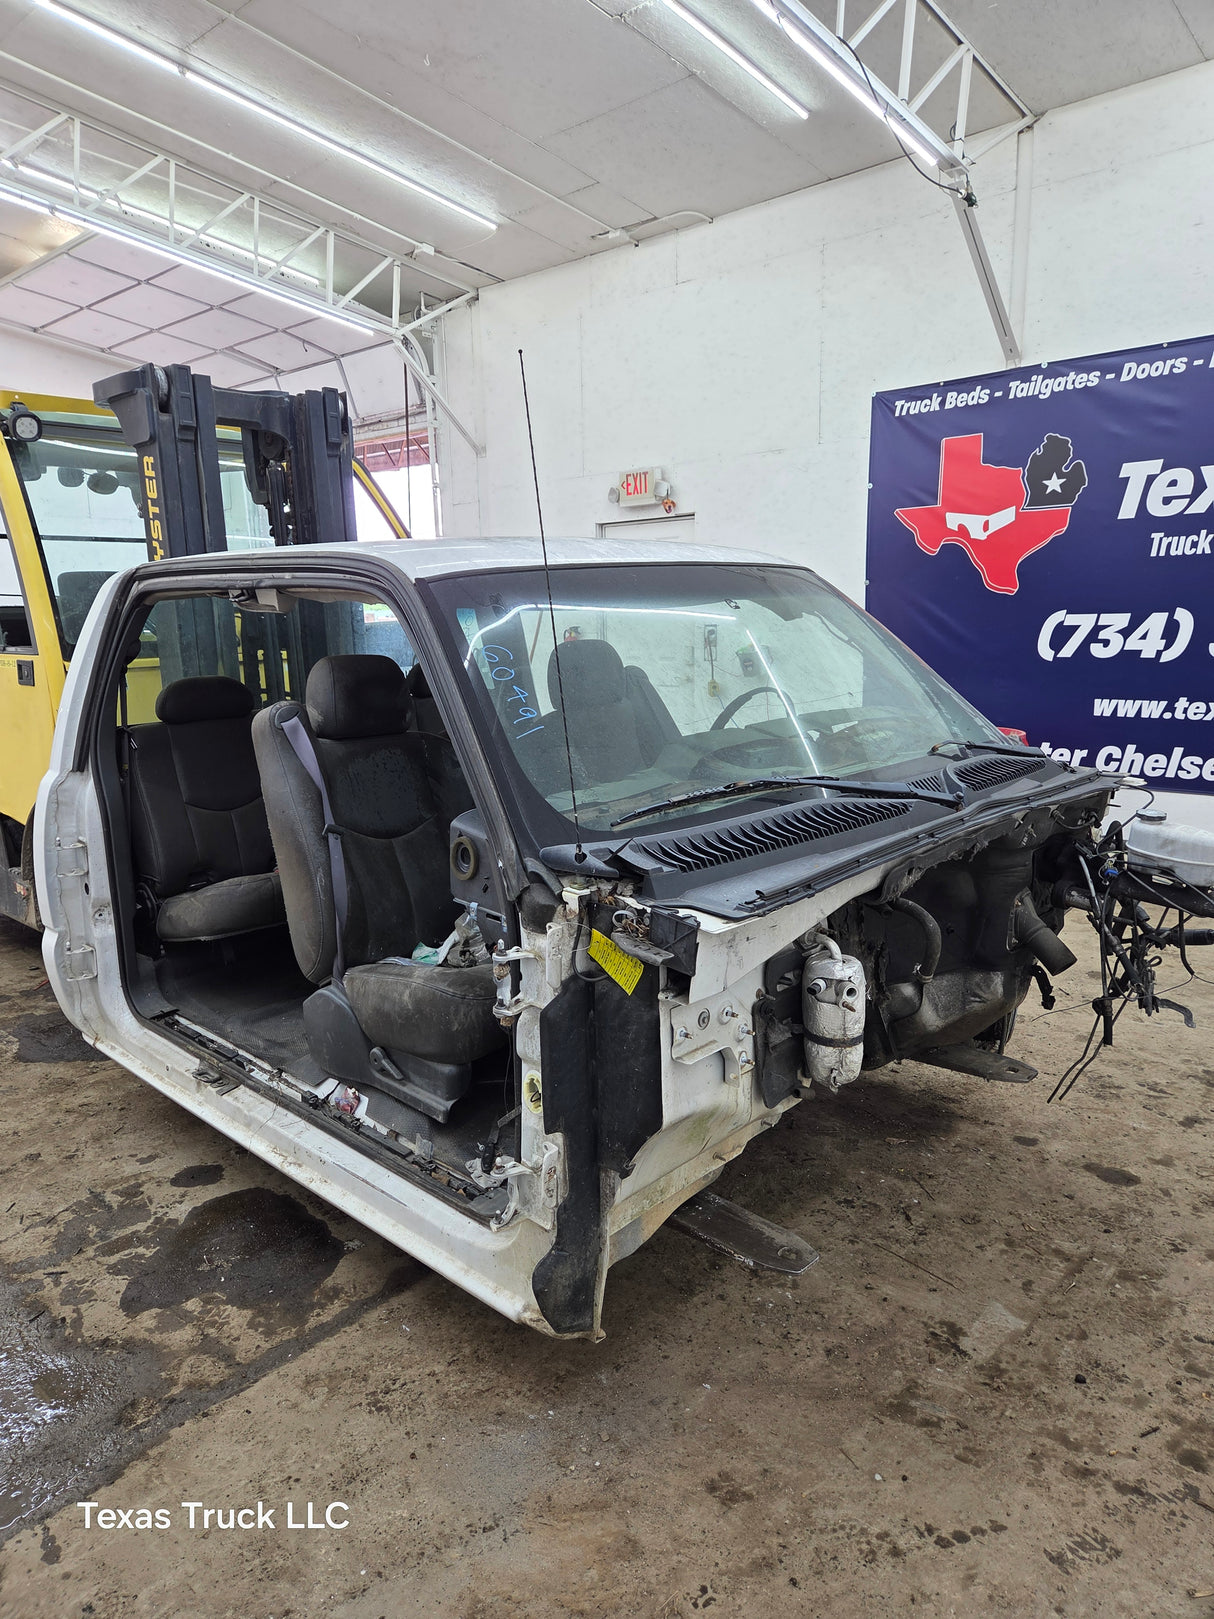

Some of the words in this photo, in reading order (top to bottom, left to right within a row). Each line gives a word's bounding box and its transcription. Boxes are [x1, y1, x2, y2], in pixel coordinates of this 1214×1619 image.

[894, 393, 941, 417] Truck
[944, 384, 990, 410] Beds
[1008, 369, 1101, 399] Tailgates
[1120, 356, 1188, 383] Doors
[625, 471, 649, 496] EXIT
[1150, 529, 1214, 557] Truck
[1037, 606, 1194, 663] (734)
[482, 644, 545, 740] 60491
